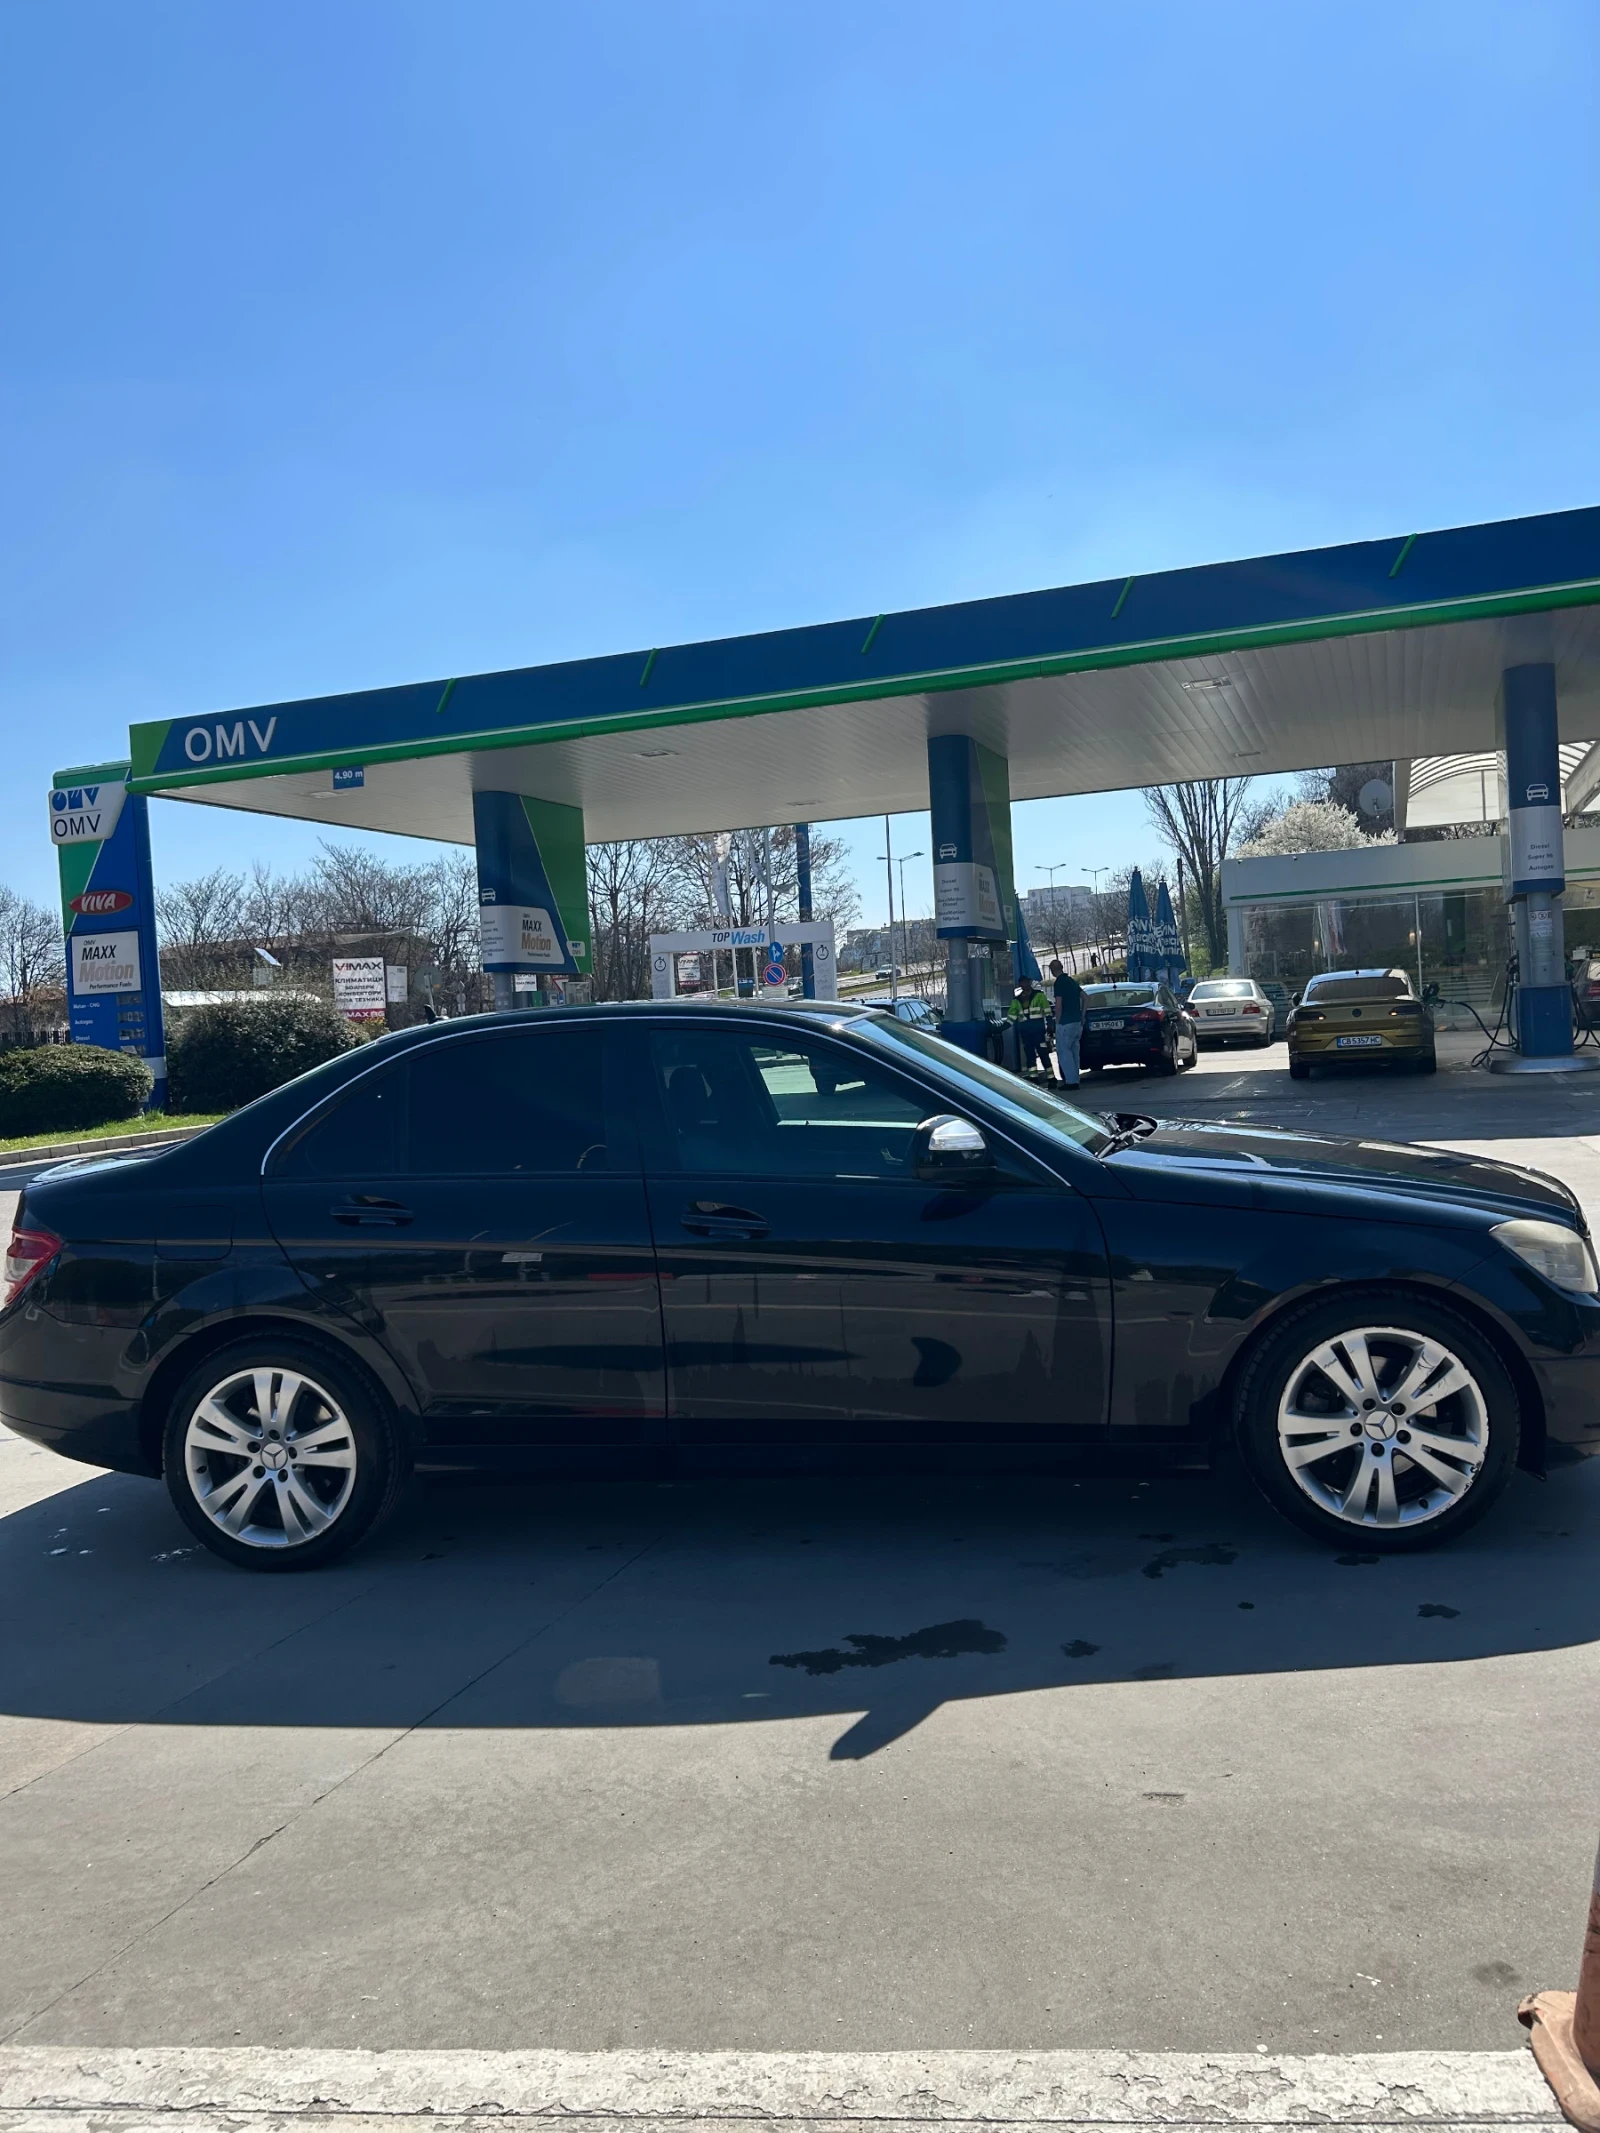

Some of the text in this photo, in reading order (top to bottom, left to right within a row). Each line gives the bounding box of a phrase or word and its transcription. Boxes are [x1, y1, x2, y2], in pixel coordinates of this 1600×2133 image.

[184, 716, 278, 762] OMV
[334, 770, 353, 779] 4.90
[52, 786, 100, 812] OMV
[54, 813, 101, 838] OMV
[81, 893, 116, 912] VIVA
[522, 919, 542, 932] MAXX
[521, 932, 552, 951] Motion
[712, 930, 765, 945] TOP Wash
[81, 945, 117, 961] MAXX
[79, 961, 135, 982] Motion
[335, 962, 382, 971] VIMAX
